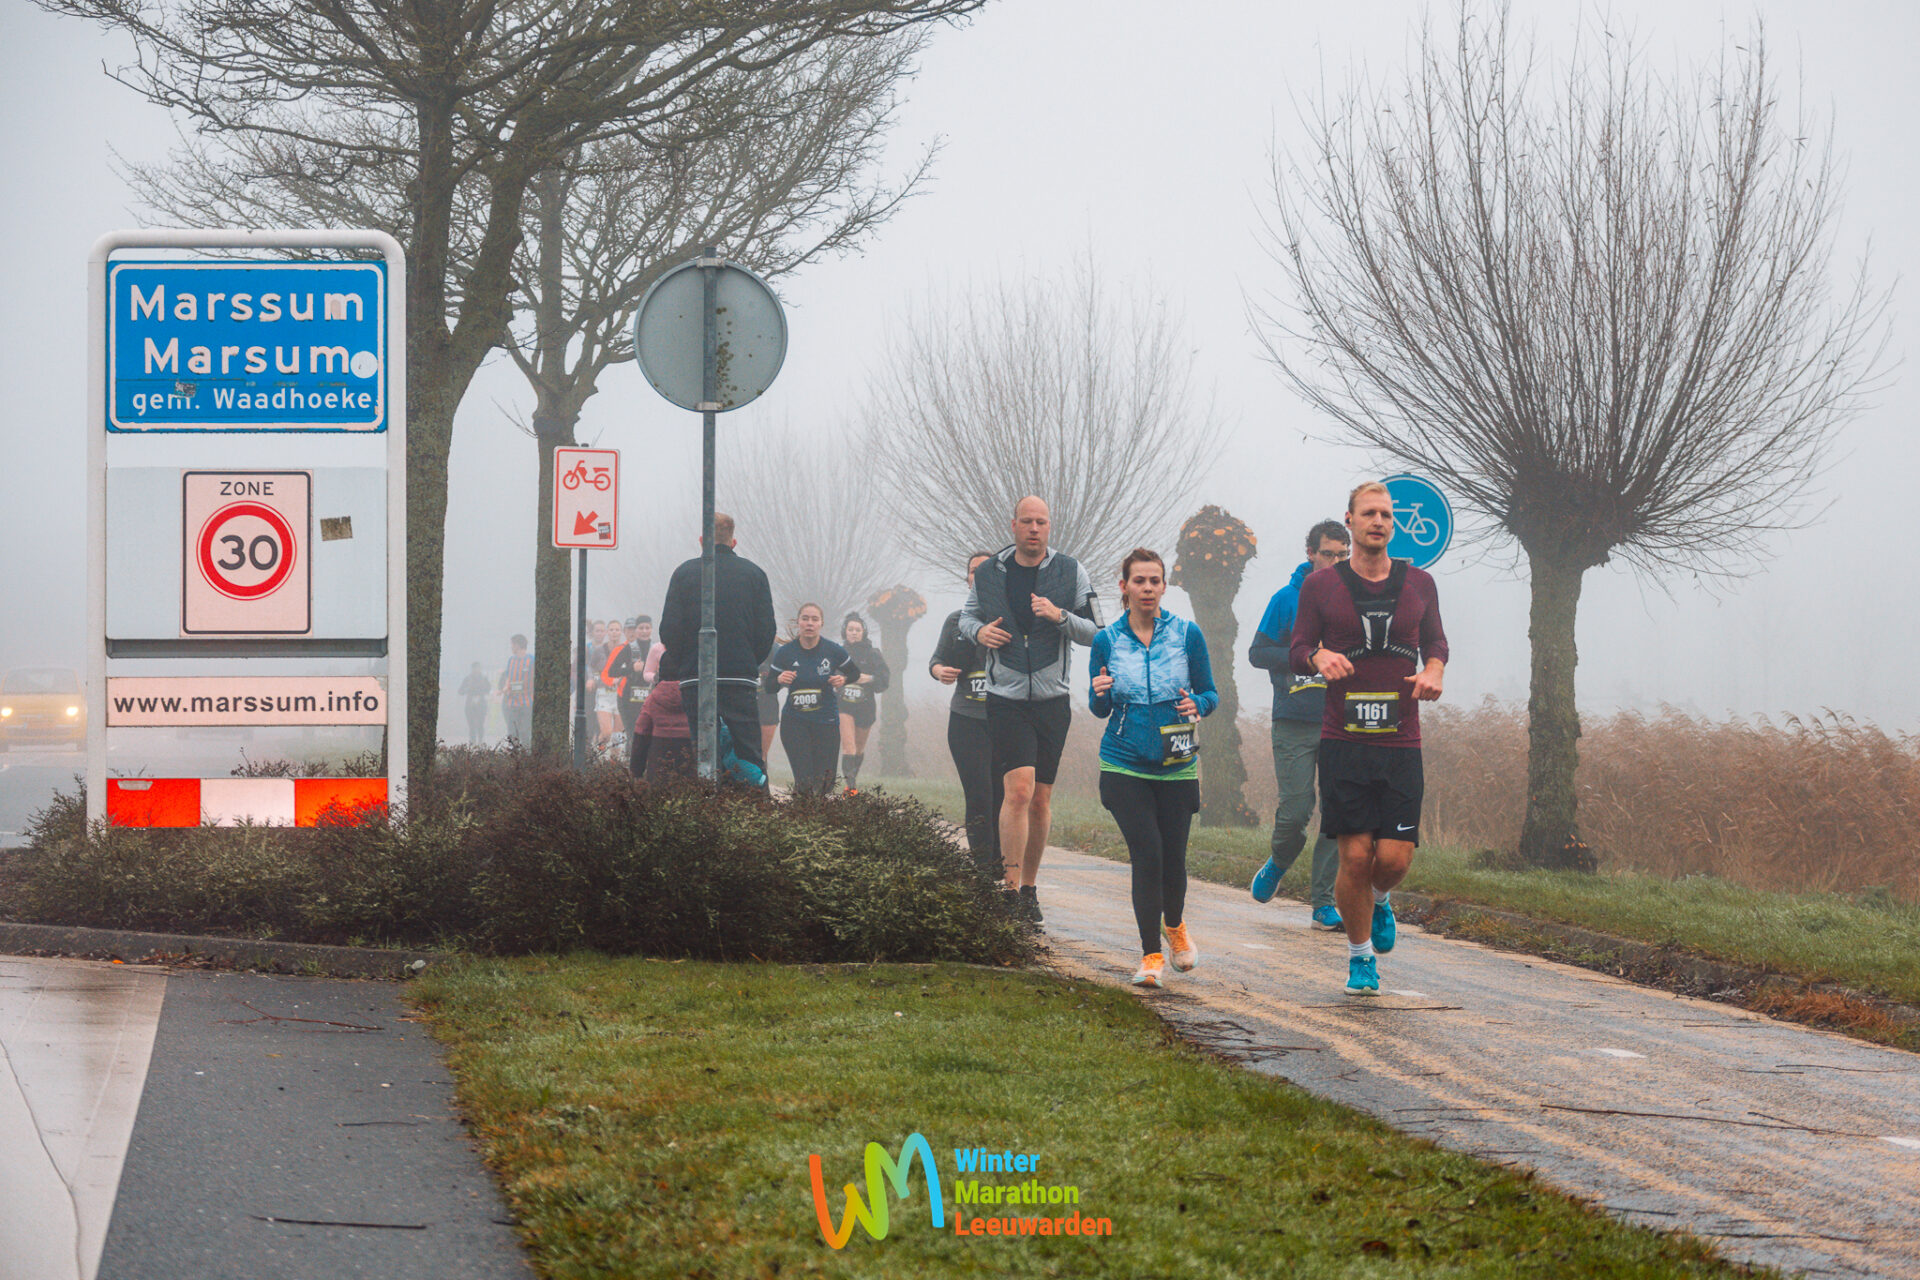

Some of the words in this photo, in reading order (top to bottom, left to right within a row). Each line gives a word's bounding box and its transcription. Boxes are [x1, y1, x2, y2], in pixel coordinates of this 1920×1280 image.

[131, 284, 364, 322] Marssum
[144, 337, 350, 374] Marsum
[213, 388, 372, 409] Waadhoeke
[220, 481, 274, 496] ZONE
[217, 535, 278, 571] 30
[114, 691, 379, 712] www.marssum.info
[793, 694, 817, 705] 2008
[1355, 703, 1388, 720] 1161
